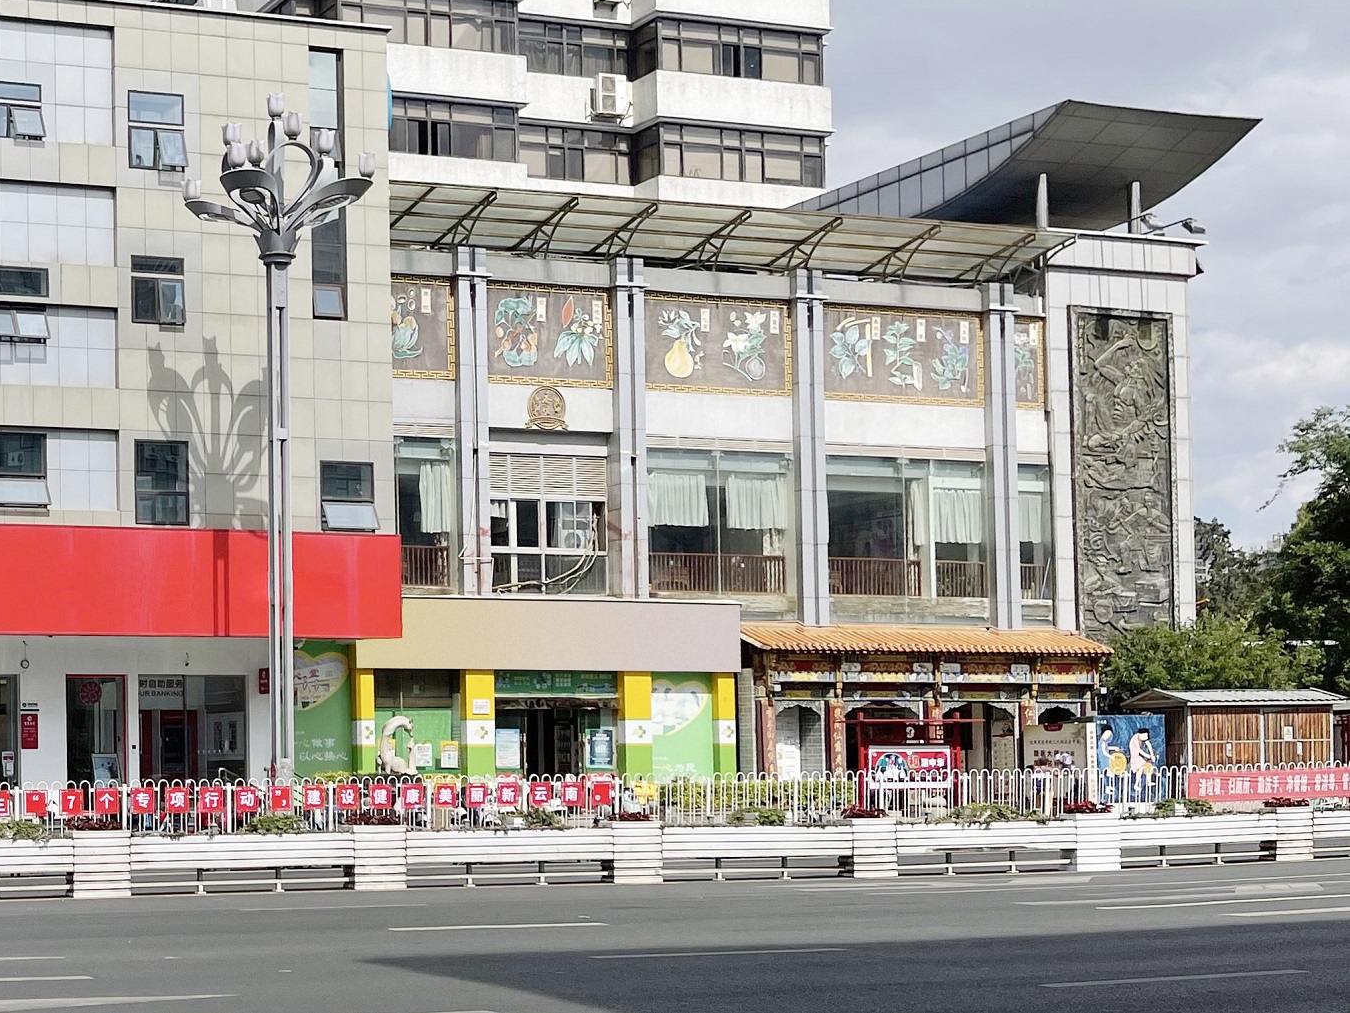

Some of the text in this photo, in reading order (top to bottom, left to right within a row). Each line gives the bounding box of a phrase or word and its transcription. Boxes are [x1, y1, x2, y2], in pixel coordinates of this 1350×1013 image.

[295, 738, 336, 748] 心做事
[299, 751, 349, 762] 以心换心
